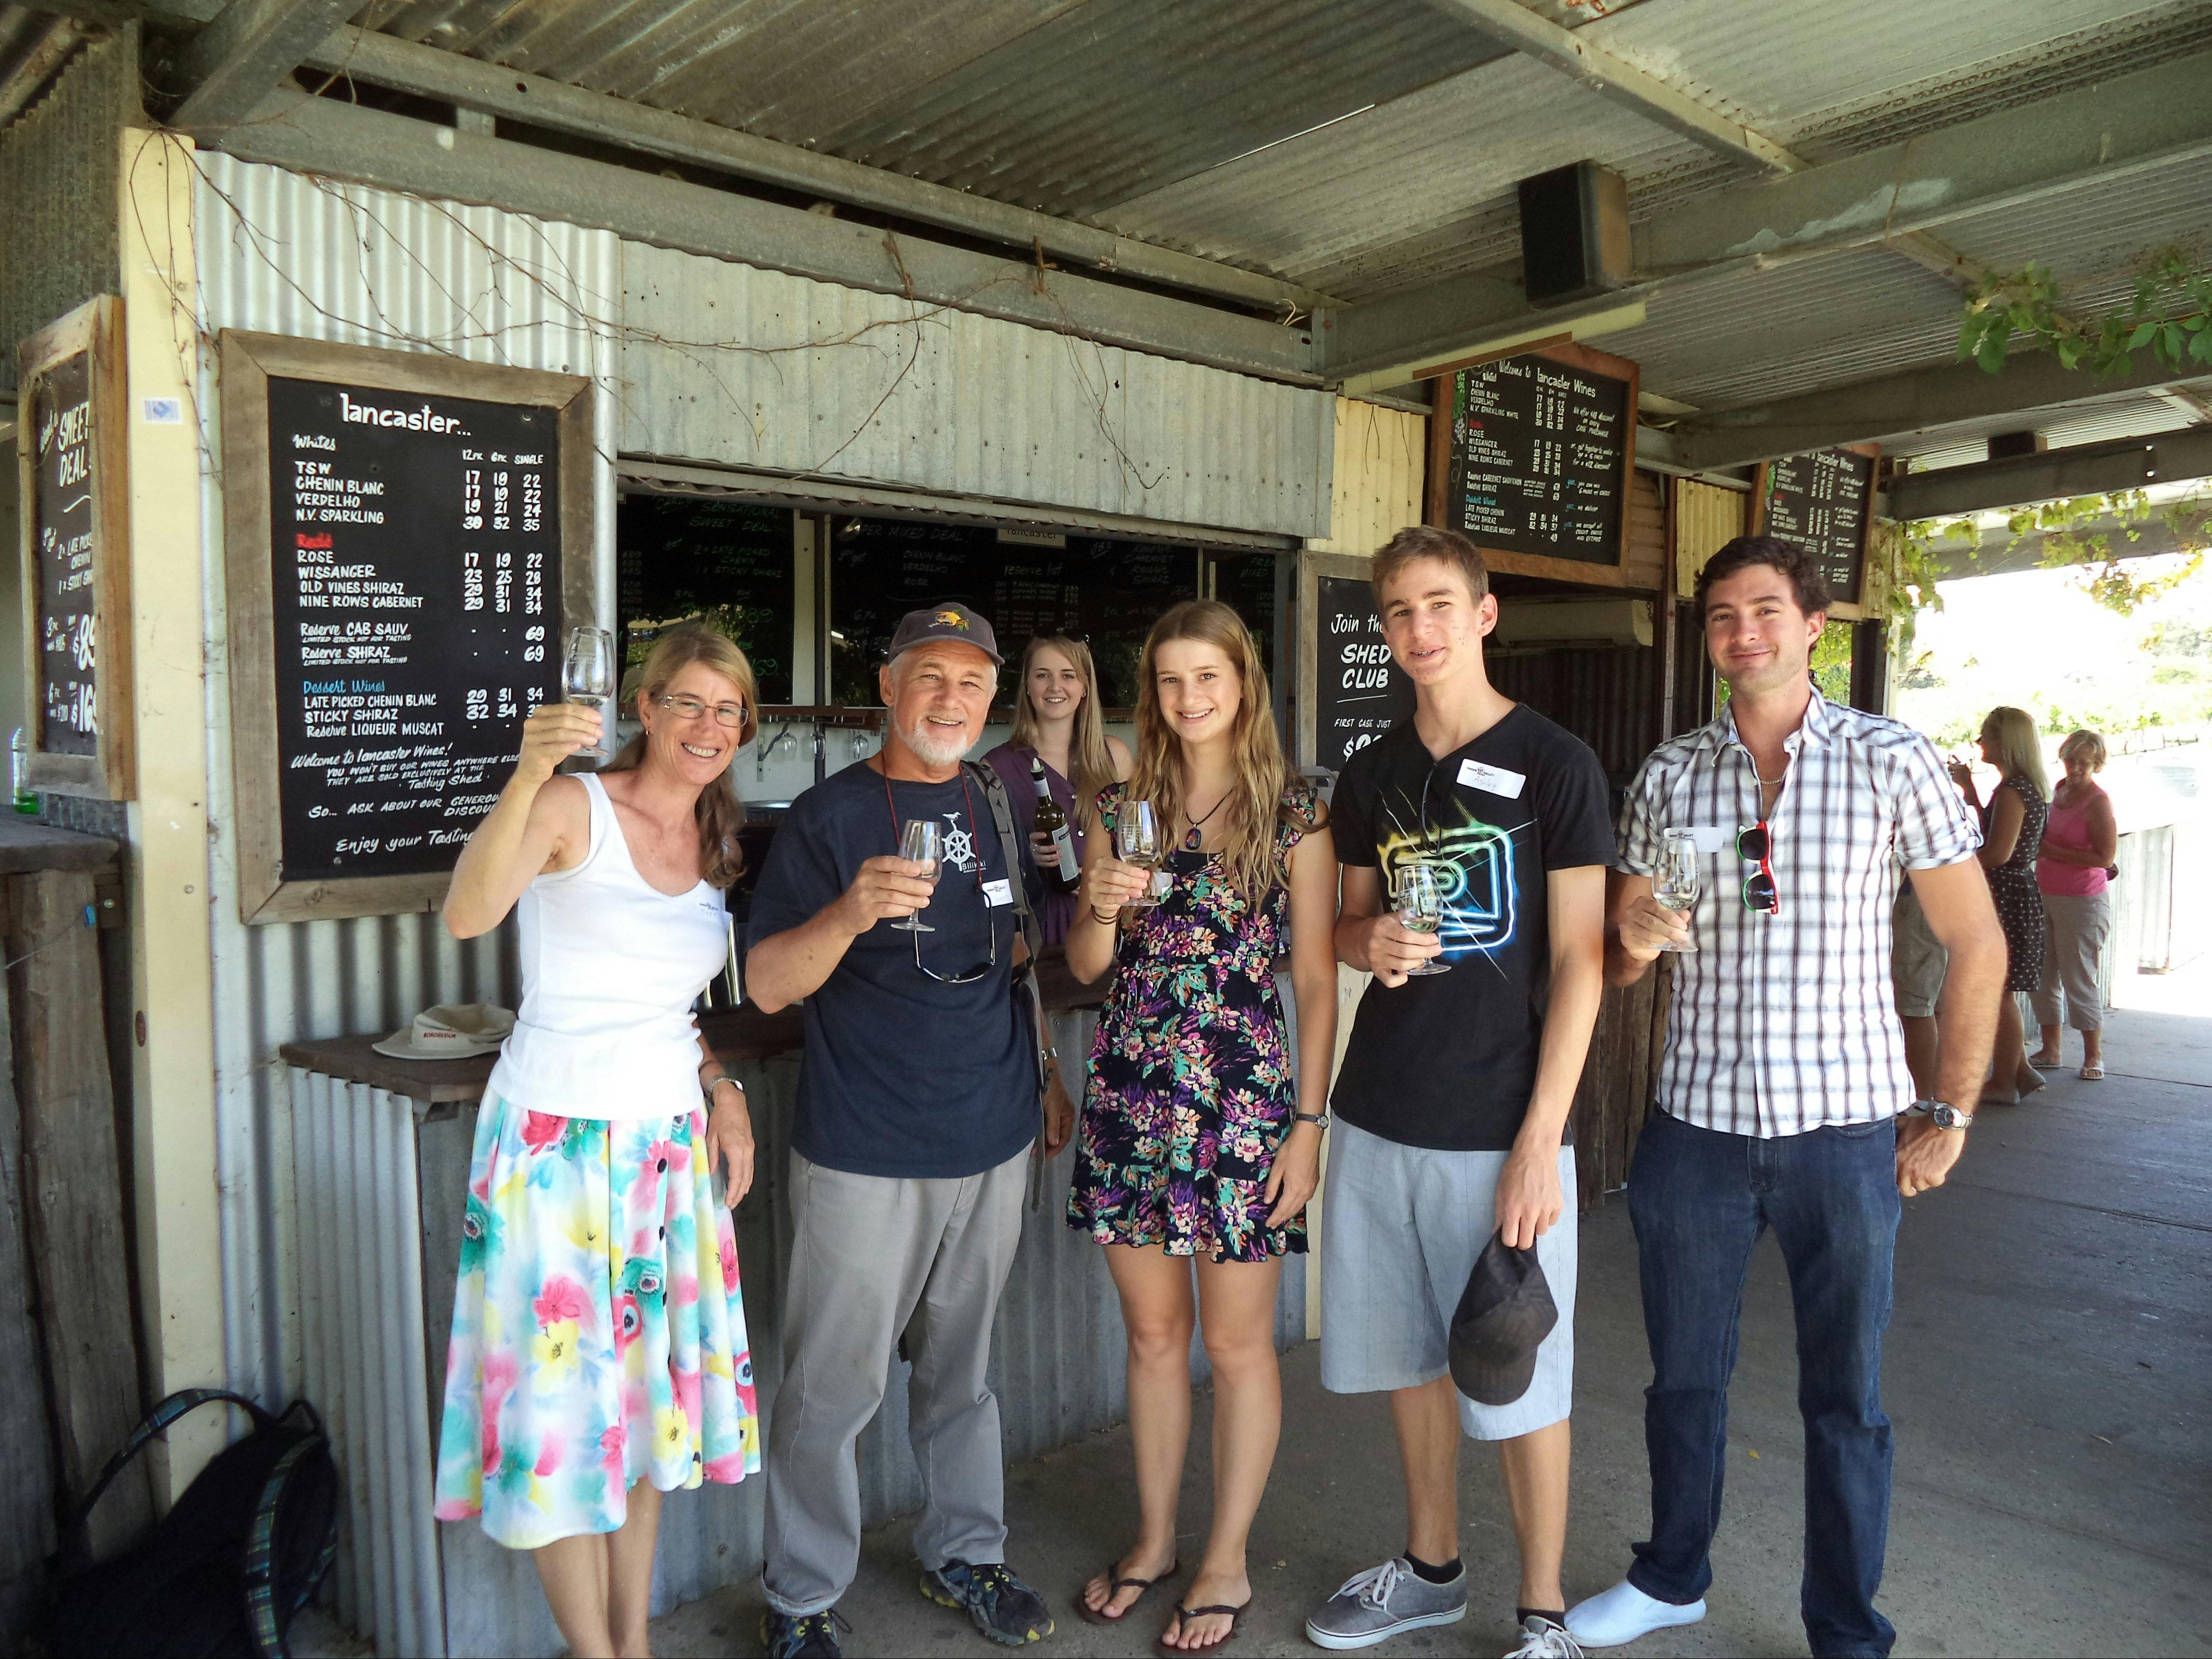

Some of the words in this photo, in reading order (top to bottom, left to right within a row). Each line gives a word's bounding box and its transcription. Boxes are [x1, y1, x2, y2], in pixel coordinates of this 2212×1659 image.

[1499, 360, 1523, 377] Welcome
[1525, 365, 1531, 378] to
[1537, 367, 1571, 390] lancaster
[1574, 379, 1596, 398] Wines
[1470, 396, 1494, 406] VERDELHO
[1486, 391, 1500, 401] BLANC
[58, 401, 90, 452] SWEET
[1469, 429, 1484, 438] ROSE
[293, 433, 336, 451] Whites
[514, 454, 544, 465] SINGLE
[1468, 454, 1479, 462] NINE
[1480, 455, 1492, 464] ROWS
[1494, 457, 1513, 466] CABERNET
[1478, 447, 1490, 455] VINES
[1491, 449, 1506, 458] SHIRAZ
[295, 461, 332, 475] TSW
[295, 476, 343, 492] CHENIN
[347, 480, 384, 495] BLANC
[465, 470, 481, 484] 17
[493, 472, 508, 486] 19
[523, 474, 541, 488] 22
[1482, 474, 1502, 483] CABERNET
[295, 493, 360, 508] VERDELHO
[466, 485, 481, 499] 17
[494, 487, 508, 501] 19
[524, 489, 541, 503] 22
[465, 499, 481, 514] 19
[494, 501, 507, 514] 21
[523, 504, 542, 517] 24
[1466, 504, 1475, 512] LATE
[1476, 506, 1489, 514] PICKED
[296, 509, 316, 521] N.V.
[320, 510, 384, 525] SPARKLING
[493, 516, 510, 530] 32
[522, 518, 541, 531] 35
[690, 515, 735, 527] SWEET
[743, 521, 772, 532] DEAL
[1465, 513, 1480, 522] STICKY
[1481, 515, 1496, 525] SHIRAZ
[889, 526, 926, 539] MIXED
[930, 528, 963, 541] DEAL
[1499, 527, 1516, 536] MUSCAT
[298, 549, 334, 563] ROSE
[465, 552, 479, 567] 17
[496, 553, 511, 568] 19
[527, 553, 543, 568] 22
[298, 565, 376, 579] WISSANGER
[465, 568, 482, 583] 23
[496, 570, 513, 585] 25
[526, 571, 541, 585] 28
[1004, 564, 1042, 576] reserve
[1046, 562, 1062, 576] list
[300, 581, 323, 593] OLD
[328, 582, 360, 594] VINES
[362, 583, 404, 595] SHIRAZ
[464, 583, 483, 597] 29
[495, 585, 509, 598] 31
[526, 586, 542, 600] 34
[300, 596, 329, 607] NINE
[333, 597, 369, 608] ROWS
[372, 597, 423, 608] CABERNET
[464, 597, 484, 610] 29
[496, 598, 510, 613] 31
[526, 601, 542, 615] 34
[301, 623, 341, 637] Reserve
[346, 622, 371, 635] CAB
[374, 623, 409, 635] SAUV
[1331, 613, 1358, 634] Join
[385, 634, 412, 642] TASTING
[526, 626, 545, 642] 69
[302, 646, 341, 660] Reserve
[347, 646, 391, 659] SHIRAZ
[524, 645, 544, 662] 69
[1341, 644, 1392, 664] SHED
[1342, 668, 1389, 688] CLUB
[303, 680, 346, 694] Dessert
[352, 680, 385, 692] Wines
[304, 696, 329, 709] LATE
[332, 695, 365, 707] PICKED
[368, 694, 403, 707] CHENIN
[406, 694, 437, 706] BLANC
[467, 689, 487, 704] 29
[498, 688, 511, 702] 31
[527, 687, 543, 701] 34
[305, 710, 349, 723] STICKY
[353, 708, 398, 721] SHIRAZ
[466, 704, 489, 719] 32
[497, 704, 517, 717] 34
[307, 725, 347, 738] Reserve
[352, 723, 397, 736] LIQUEUR
[402, 722, 444, 735] MUSCAT
[1334, 718, 1355, 728] FIRST
[1358, 719, 1373, 728] CASE
[1377, 719, 1392, 728] JUST
[291, 752, 340, 768] Welcome
[343, 749, 354, 764] to
[413, 742, 453, 757] Wines!
[327, 768, 345, 778] YOU
[380, 764, 397, 772] BUY
[400, 762, 417, 770] OUR
[421, 760, 449, 769] WINES
[454, 756, 498, 767] ANYWHERE
[501, 754, 520, 763] ELSE
[327, 777, 350, 787] THEY
[355, 775, 374, 784] ARE
[378, 773, 399, 781] SOLD
[402, 768, 452, 779] EXCLUSIVELY
[409, 775, 446, 791] Tasting
[448, 771, 483, 785] Shed
[348, 802, 373, 814] ASK
[381, 800, 417, 812] ABOUT
[420, 799, 442, 808] OUR
[451, 794, 500, 806] GENEROU
[444, 804, 495, 816] DISCOU
[336, 836, 379, 853] Enjoy
[385, 835, 421, 852] your
